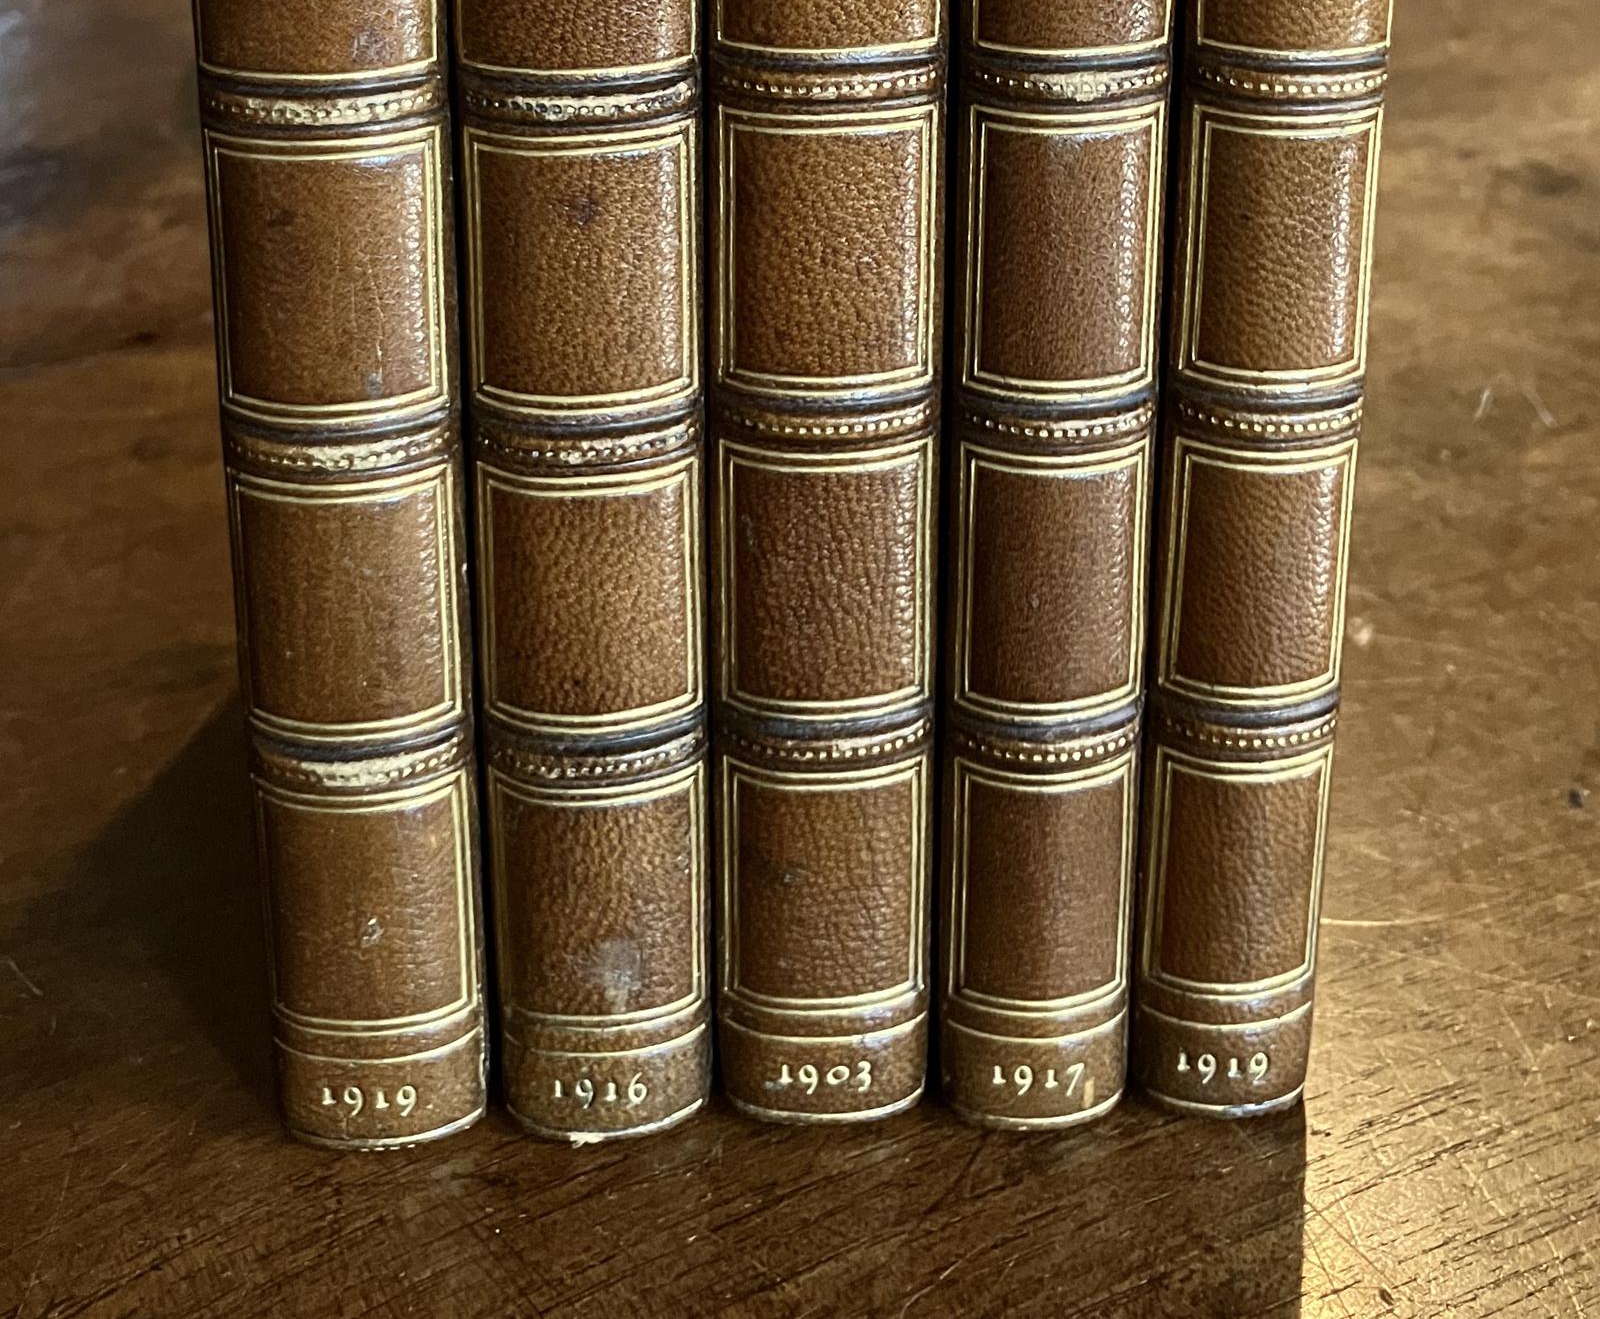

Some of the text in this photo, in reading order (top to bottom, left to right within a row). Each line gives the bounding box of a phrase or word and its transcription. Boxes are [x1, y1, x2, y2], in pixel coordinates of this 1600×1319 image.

[780, 1060, 873, 1095] 1903
[993, 1062, 1087, 1096] 1917
[1177, 1051, 1270, 1084] 1919
[321, 1085, 418, 1117] 1919
[553, 1072, 649, 1109] 1916
